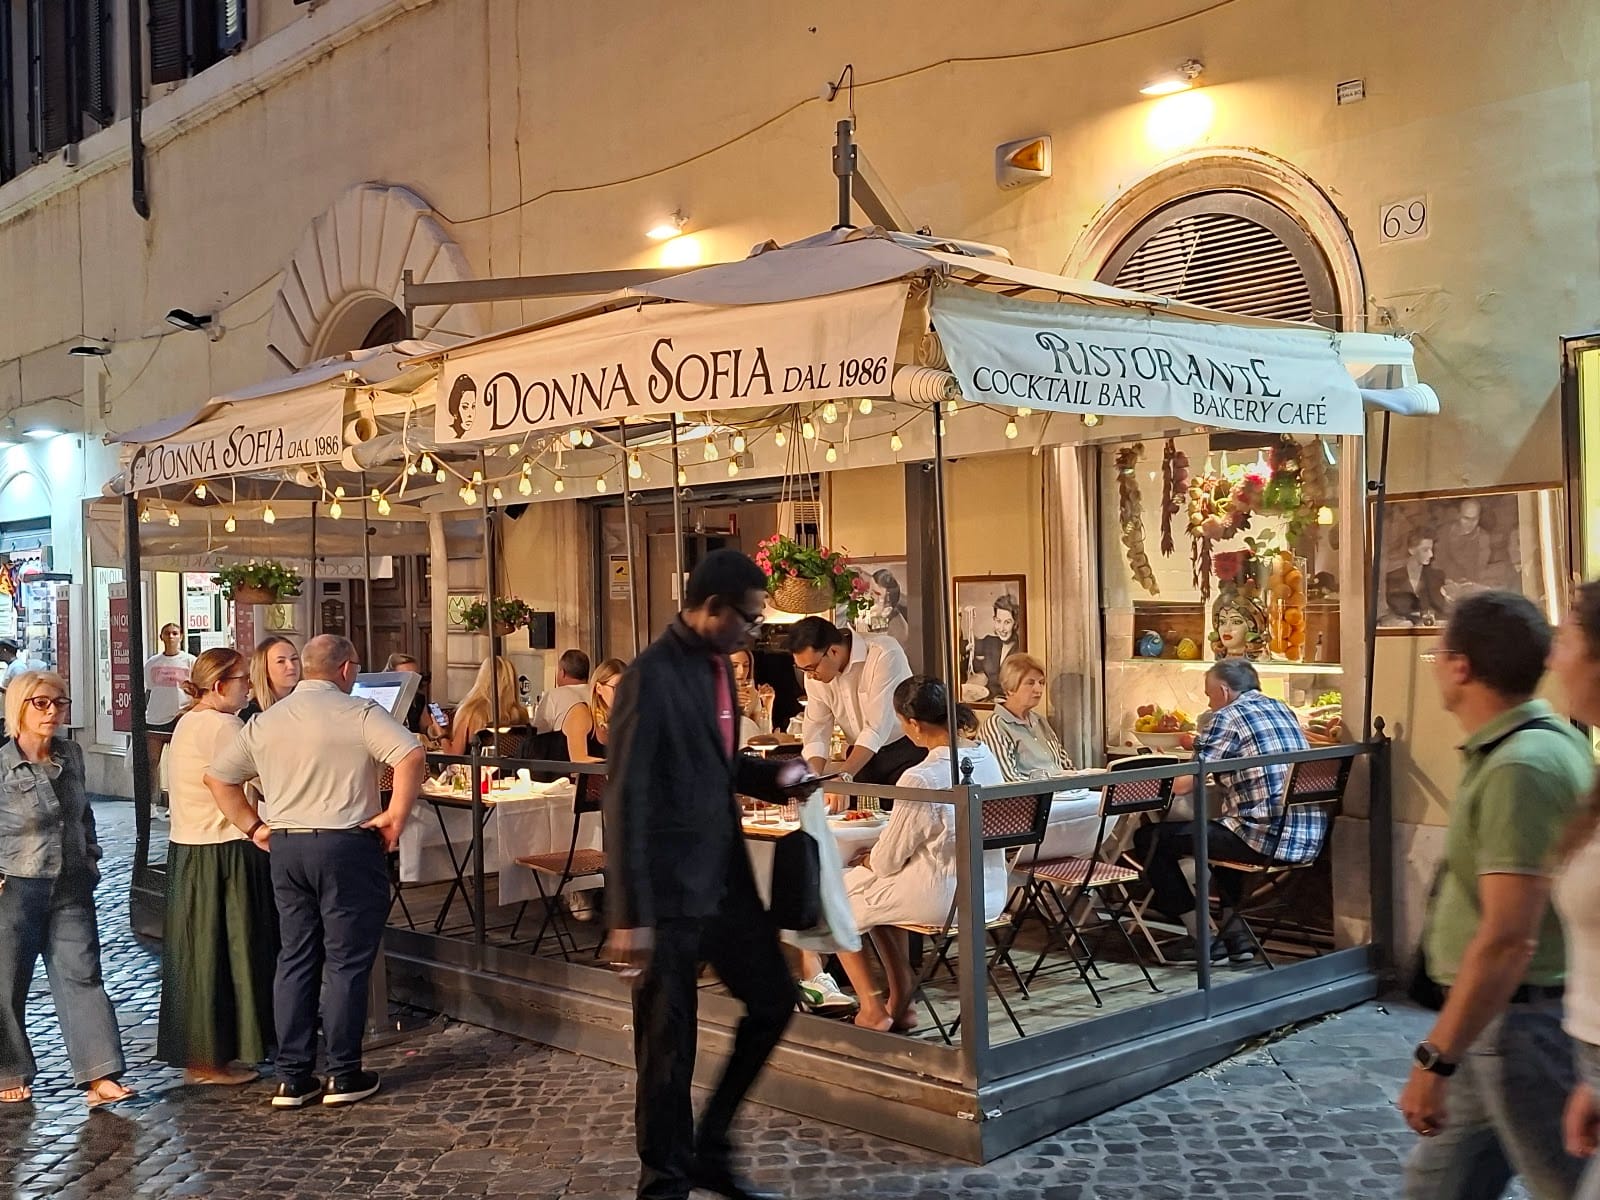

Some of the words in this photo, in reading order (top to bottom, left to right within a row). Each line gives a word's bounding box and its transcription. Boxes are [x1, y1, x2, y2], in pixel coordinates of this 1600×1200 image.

[1383, 200, 1426, 238] 69
[483, 362, 639, 432] DONNA
[648, 338, 773, 404] SOFIA
[782, 366, 830, 394] DAL
[837, 356, 889, 388] 1986
[1034, 331, 1282, 397] RISTORANTE
[972, 366, 1092, 405] COCKTAIL
[1098, 380, 1146, 409] BAR
[1192, 392, 1275, 424] BAKERY
[1277, 396, 1328, 426] CAFÉ
[145, 439, 218, 485] DONNA
[223, 424, 284, 469] SOFIA
[287, 439, 312, 459] DAL
[314, 435, 339, 457] 1986
